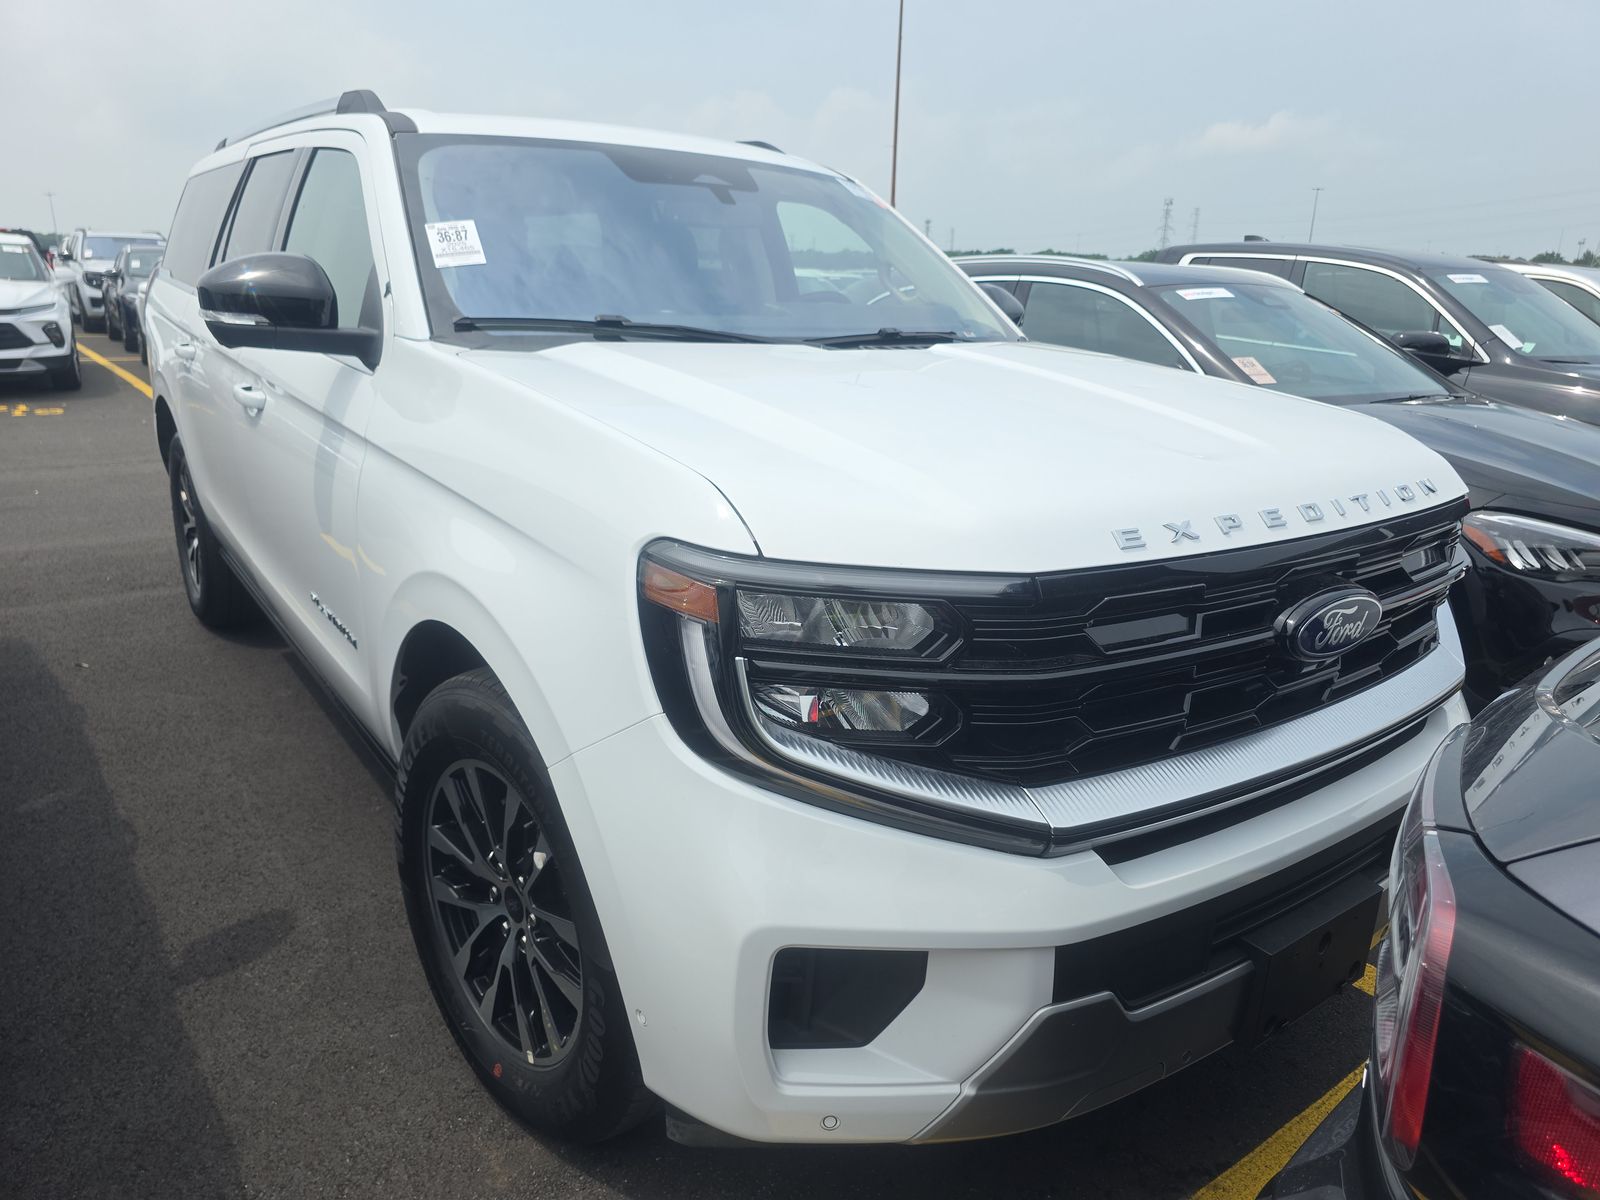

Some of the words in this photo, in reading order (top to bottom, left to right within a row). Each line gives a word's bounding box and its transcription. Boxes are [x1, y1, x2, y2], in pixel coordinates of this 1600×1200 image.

[436, 230, 468, 243] 36:87
[1113, 478, 1438, 550] EXPEDITION
[1315, 605, 1368, 650] Ford
